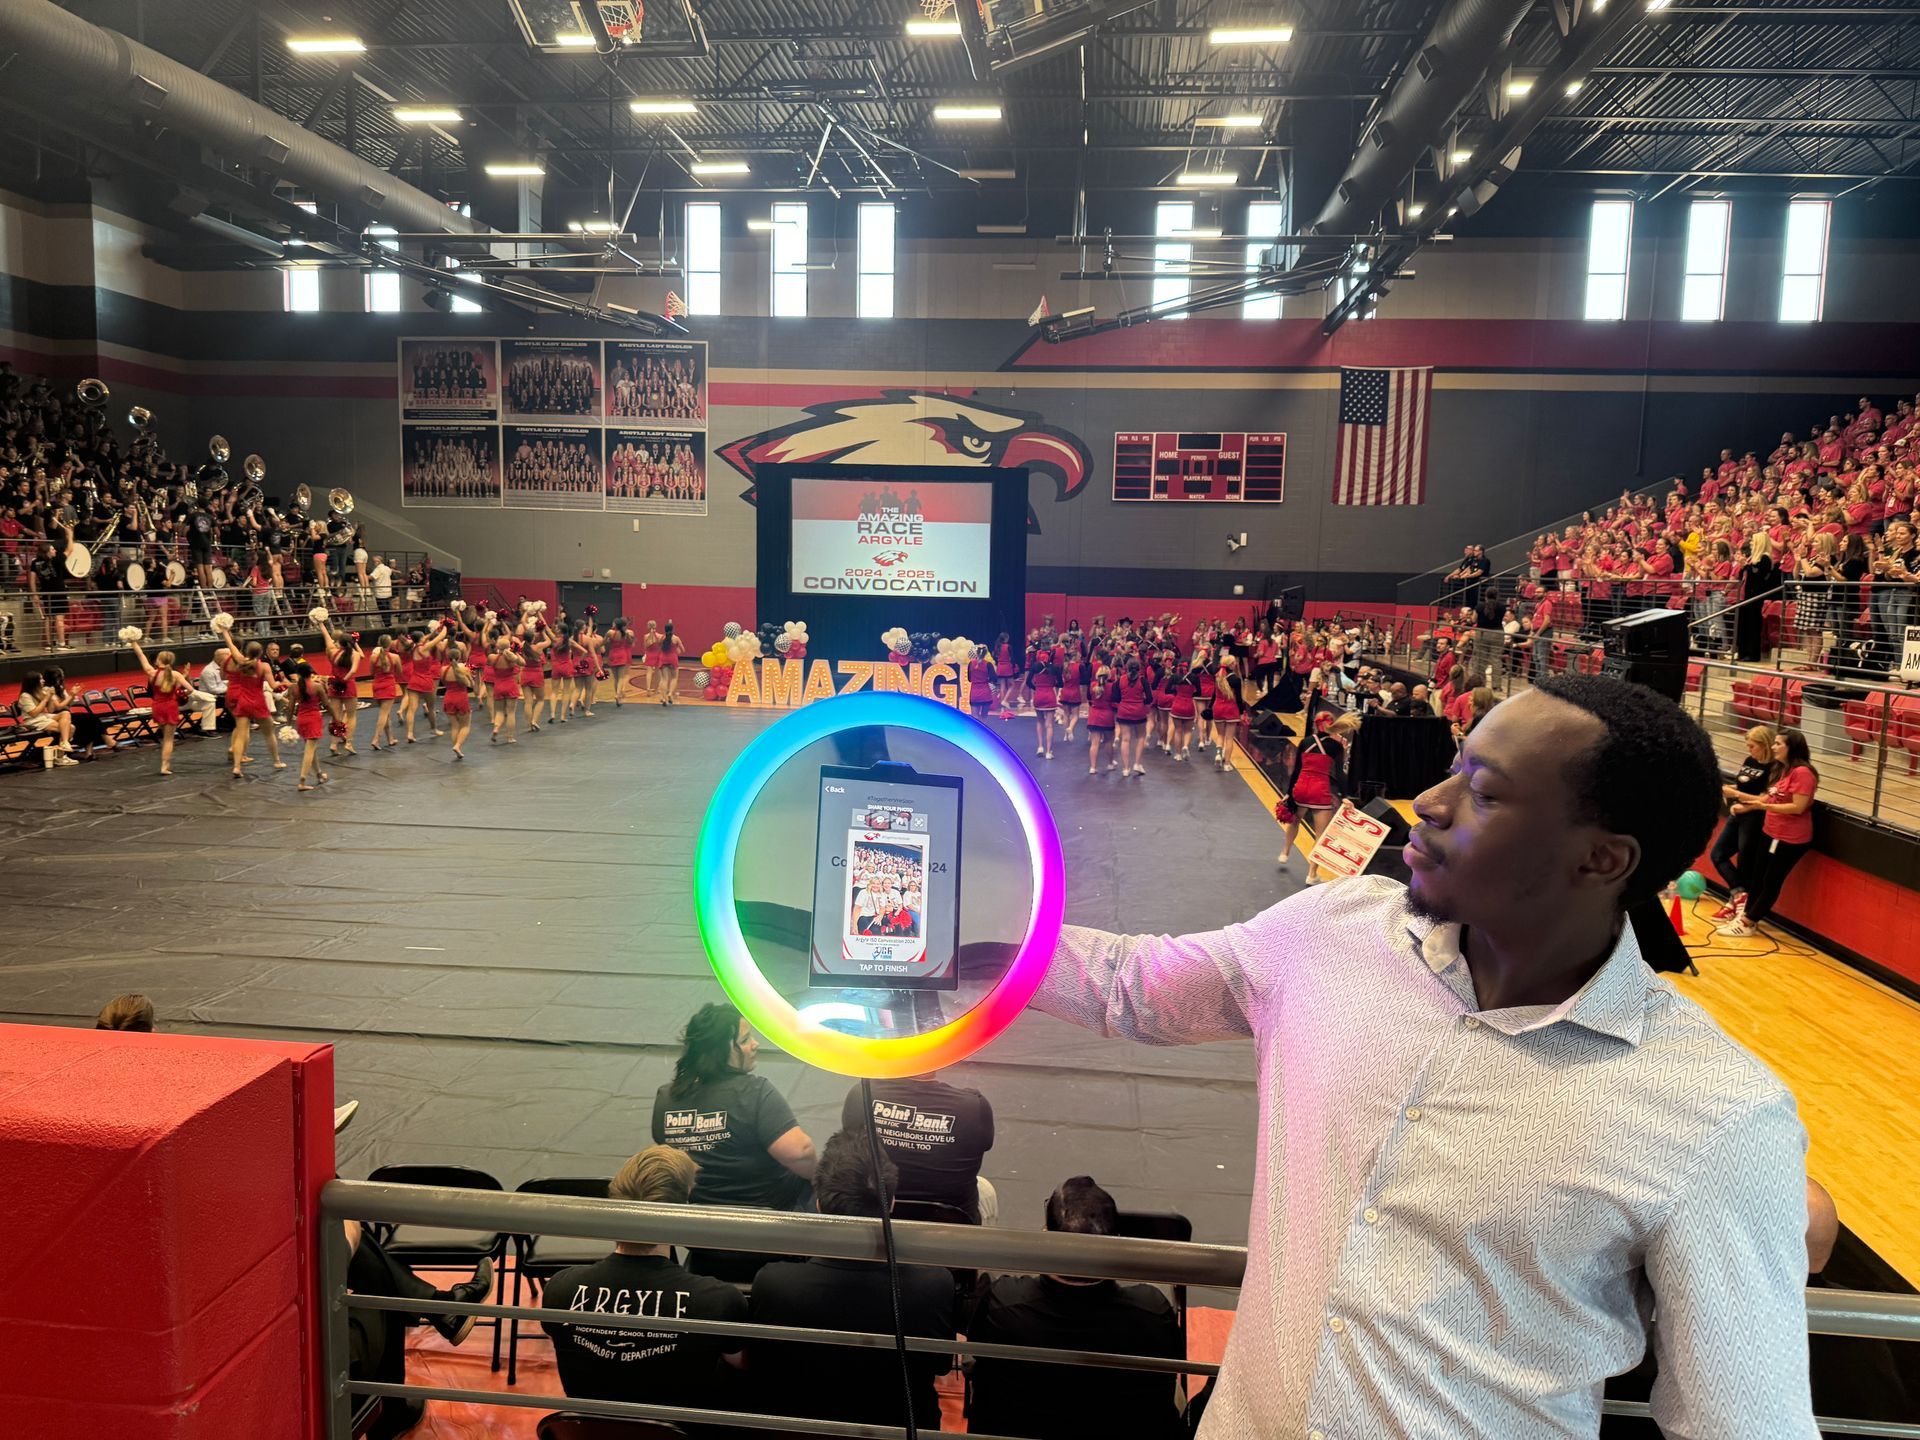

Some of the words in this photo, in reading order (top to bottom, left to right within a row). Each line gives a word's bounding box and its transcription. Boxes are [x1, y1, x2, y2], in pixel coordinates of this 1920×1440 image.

[1159, 451, 1179, 459] HOME
[1218, 451, 1240, 459] GUEST
[857, 513, 924, 522] AMAZING
[857, 522, 923, 535] RACE
[857, 535, 923, 546] ARGYLE
[845, 568, 882, 577] 2024
[897, 570, 935, 578] 2025
[803, 576, 977, 593] CONVOCATION
[928, 862, 947, 873] 24
[874, 964, 884, 972] TO
[885, 965, 908, 973] FINISH
[666, 1113, 693, 1127] Point
[696, 1112, 723, 1129] Bank
[873, 1102, 911, 1121] Point
[914, 1114, 950, 1129] Bank
[706, 1132, 722, 1142] LOVE
[721, 1131, 731, 1139] US
[883, 1129, 924, 1140] NEIGHBORS
[925, 1134, 945, 1143] LOVE
[882, 1138, 898, 1146] YOU
[898, 1140, 916, 1149] WILL
[916, 1143, 932, 1151] TOO
[575, 1325, 617, 1336] INDEPENDENT
[619, 1330, 645, 1338] SCHOOL
[647, 1331, 679, 1339] DISTRICT
[572, 1334, 617, 1360] TECHNOLOGY
[620, 1343, 678, 1362] DEPARTMENT
